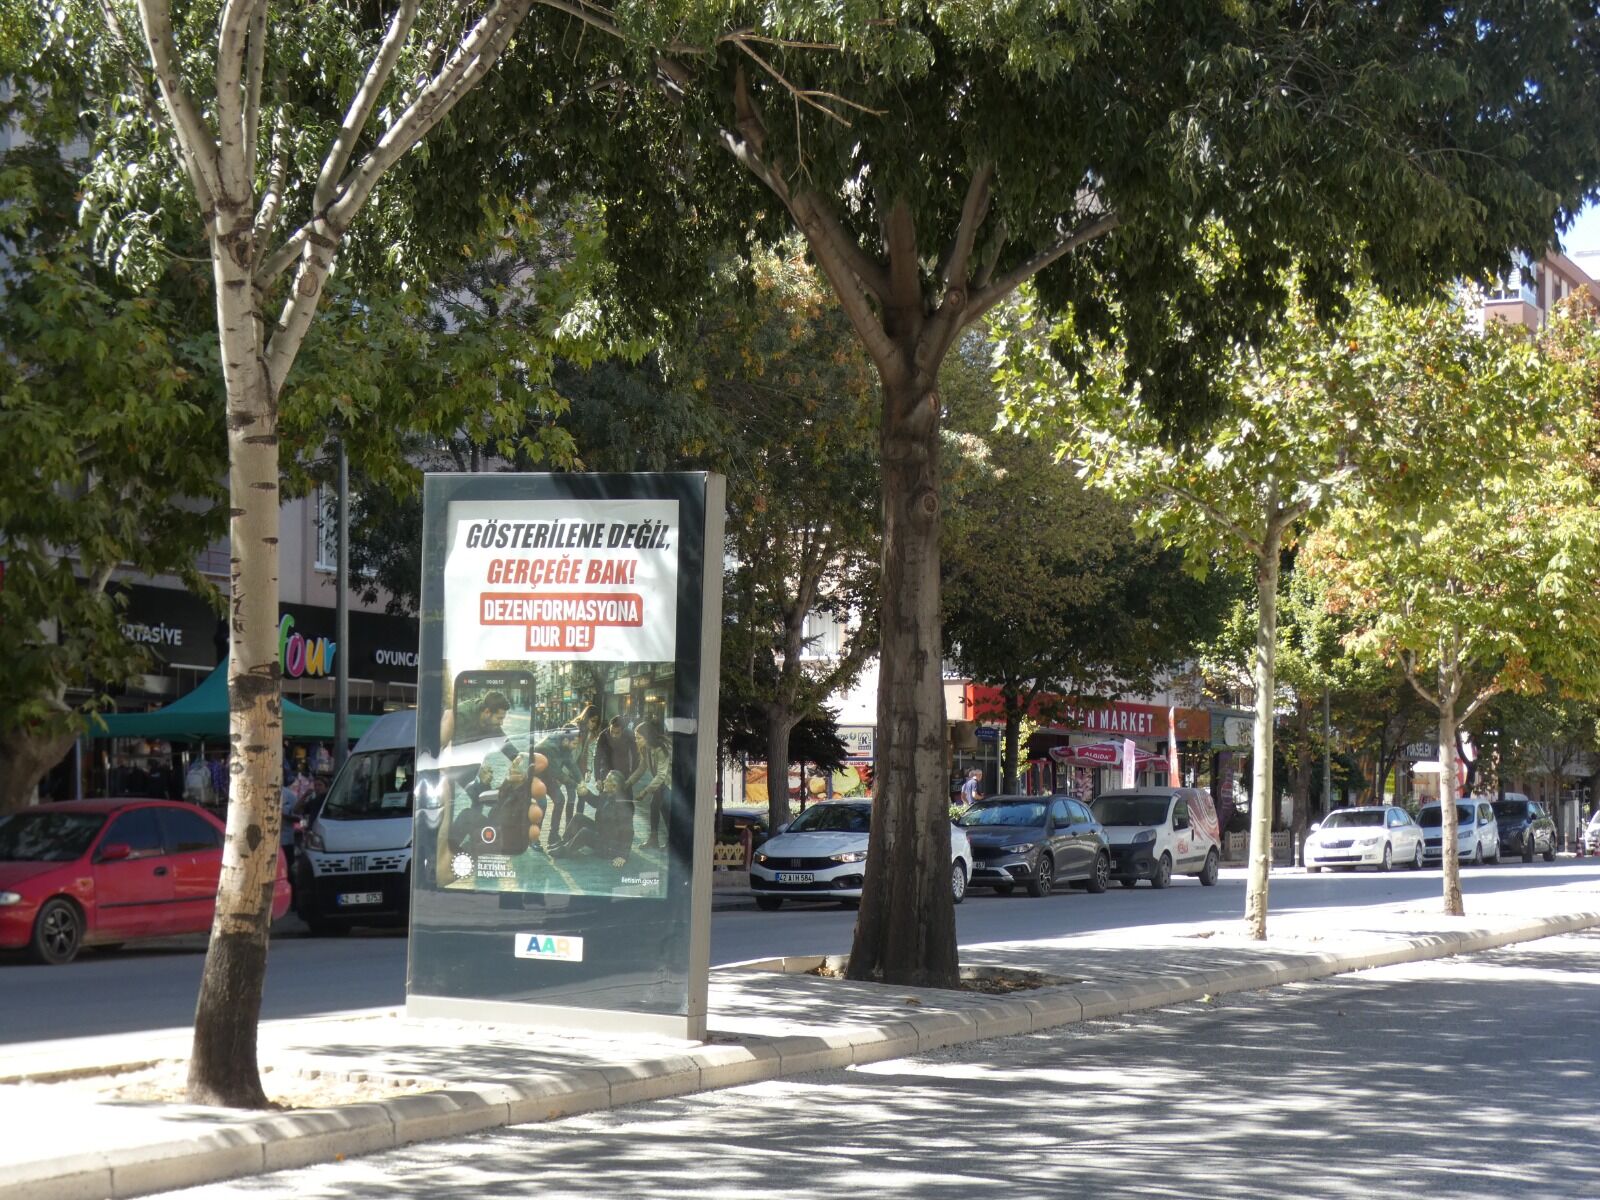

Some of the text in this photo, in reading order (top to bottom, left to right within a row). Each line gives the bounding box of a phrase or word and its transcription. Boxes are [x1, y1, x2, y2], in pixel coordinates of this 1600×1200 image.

[465, 519, 671, 551] GÖSTERİLENE DEĞİL,
[487, 554, 638, 589] GERÇEĞE BAK!
[484, 599, 639, 622] DEZENFORMASYONA
[530, 626, 590, 647] DUR DE!
[1100, 709, 1154, 733] MARKET
